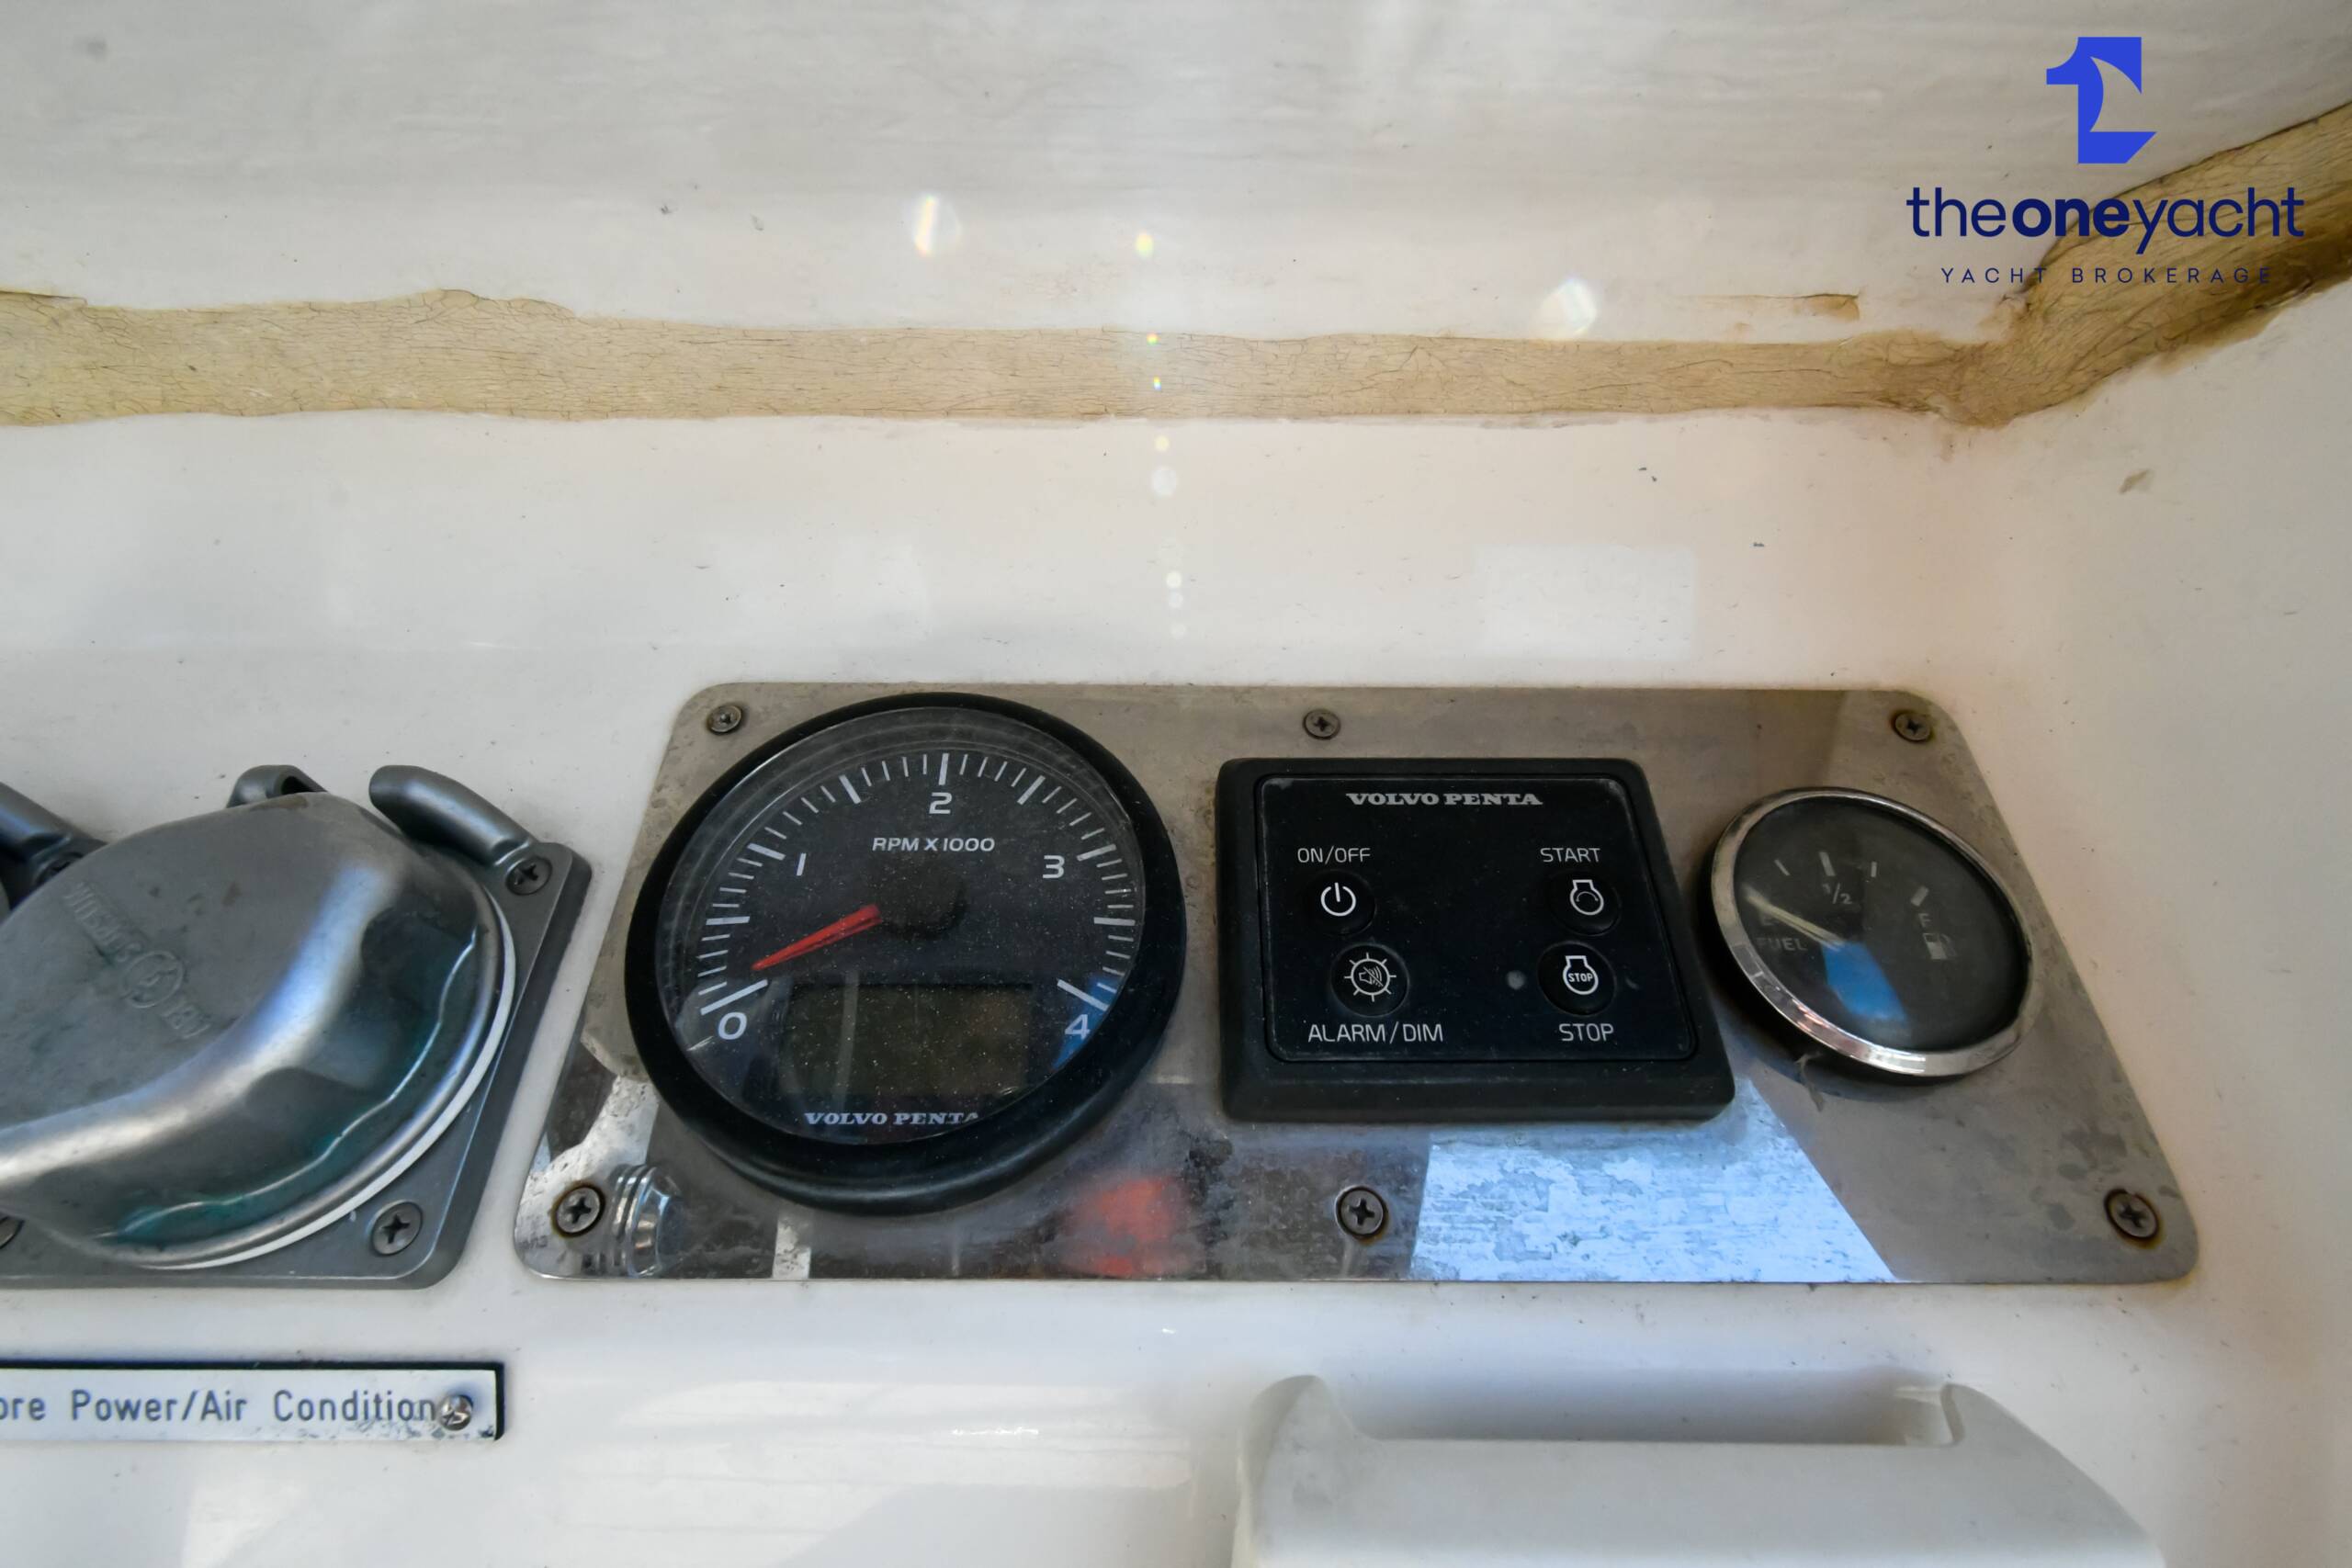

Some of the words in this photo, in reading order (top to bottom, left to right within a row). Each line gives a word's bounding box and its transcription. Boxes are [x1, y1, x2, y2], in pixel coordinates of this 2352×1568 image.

[929, 793, 952, 814] 2
[1345, 793, 1440, 806] VOLVO
[1444, 793, 1544, 806] PENTA
[872, 838, 920, 852] RPM
[943, 838, 995, 852] 1000
[1296, 846, 1371, 864] ON/OFF
[1540, 847, 1601, 863] START
[796, 853, 807, 875] 1
[1043, 855, 1065, 878] 3
[1567, 973, 1593, 982] STOP
[717, 1012, 747, 1040] 0
[1064, 1014, 1091, 1039] 4
[1558, 1022, 1614, 1042] STOP
[804, 1112, 888, 1124] VOLVO
[71, 1389, 248, 1422] Power/Air
[274, 1389, 436, 1422] Condition
